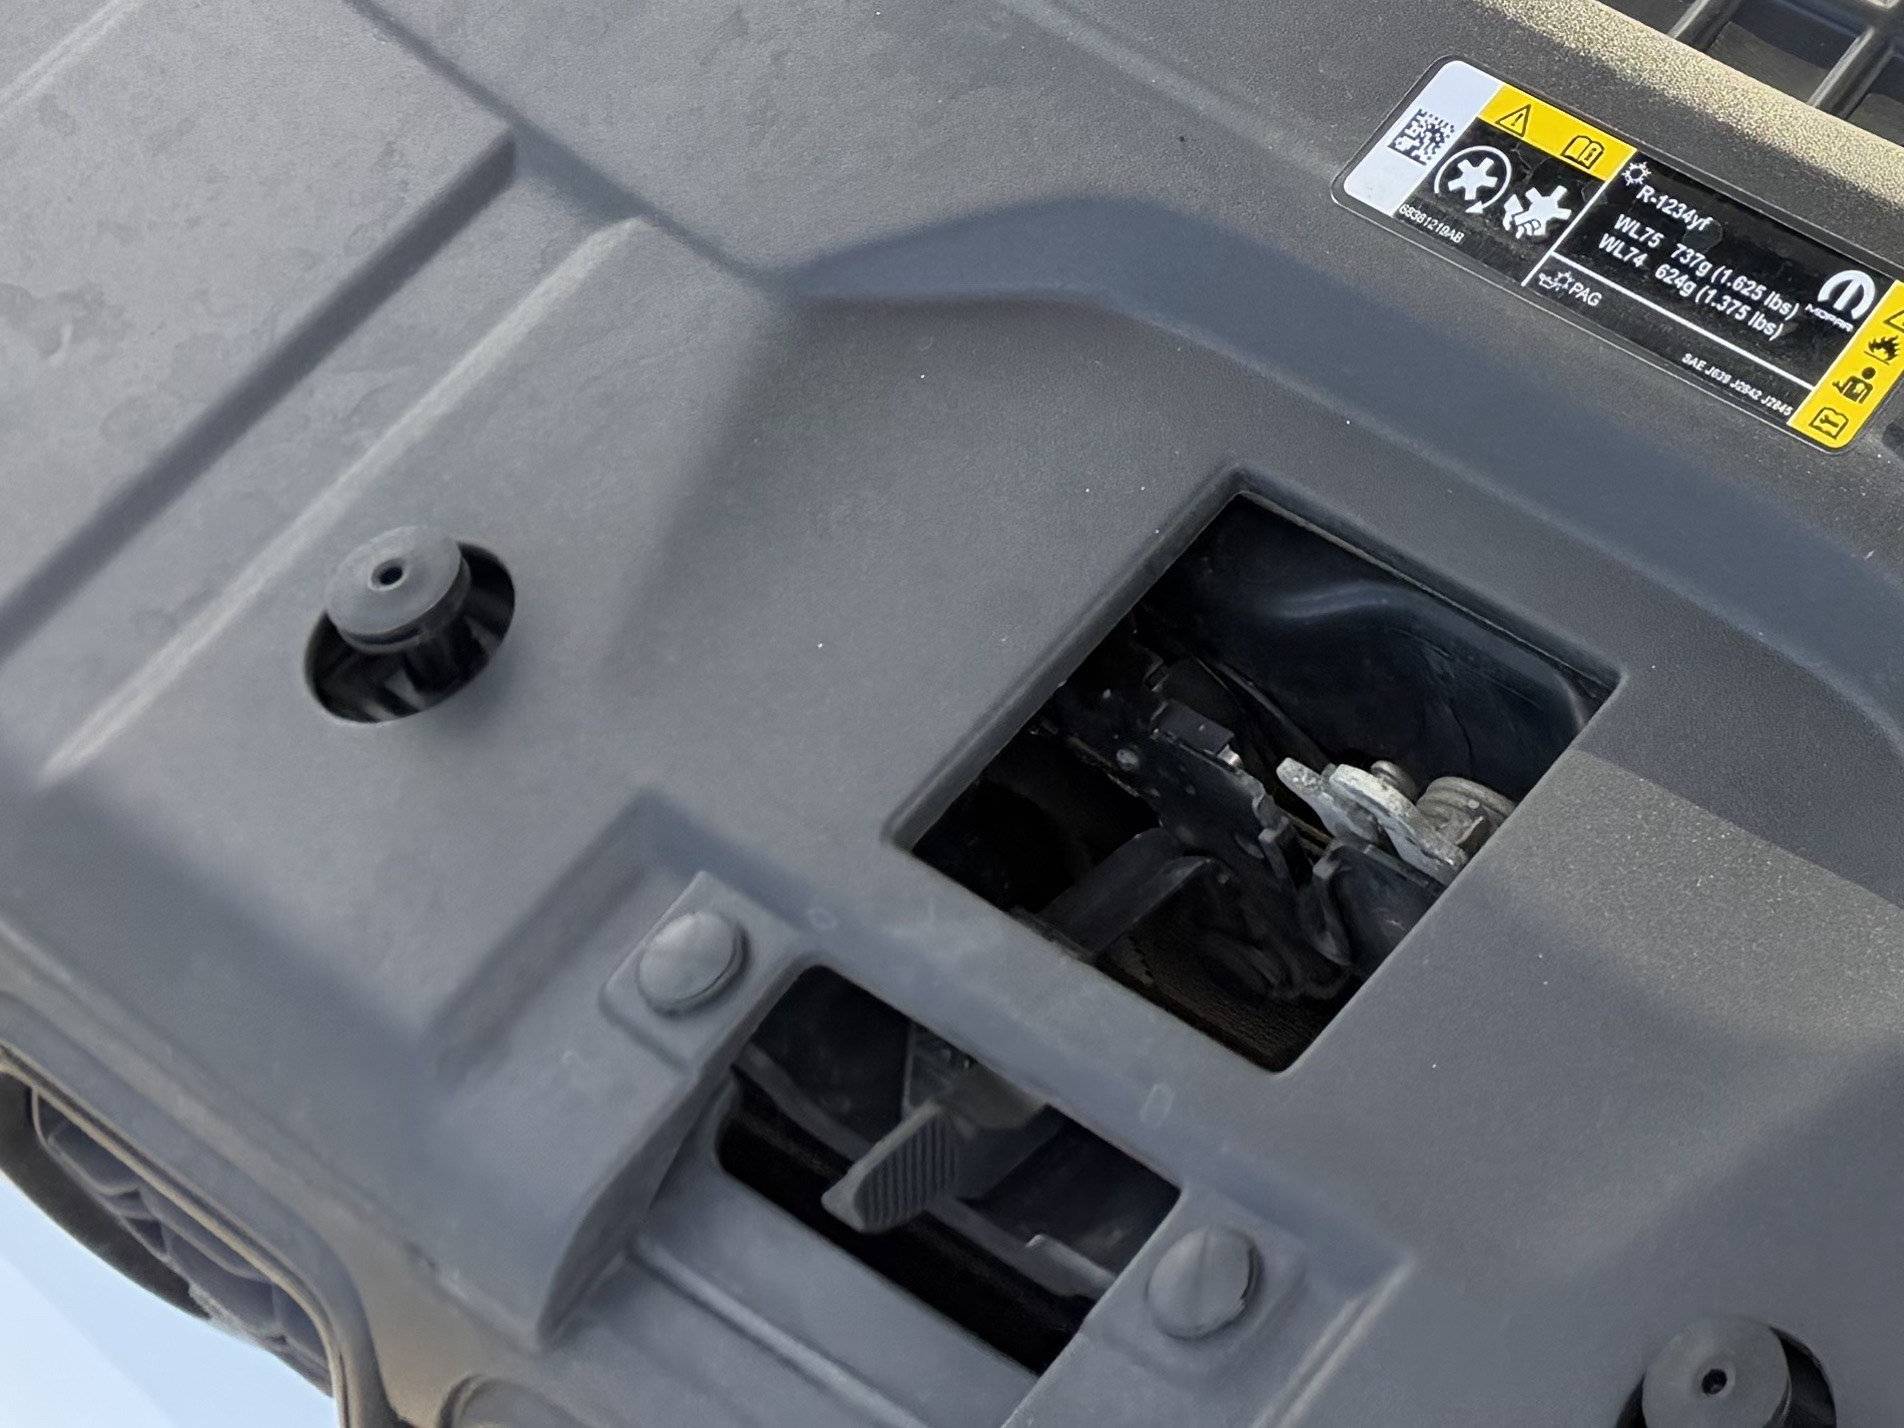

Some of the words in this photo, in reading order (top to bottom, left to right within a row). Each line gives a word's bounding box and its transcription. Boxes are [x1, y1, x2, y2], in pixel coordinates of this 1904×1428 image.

[1636, 185, 1713, 231] R-1234yf
[1613, 213, 1665, 248] WL75
[1670, 242, 1713, 278] 737g
[1711, 265, 1767, 301] (1.625
[1764, 293, 1800, 321] lbs)
[1568, 281, 1602, 307] PAG
[1598, 233, 1649, 268] WL74
[1655, 263, 1697, 299] 624g
[1695, 285, 1751, 321] (1.375
[1748, 312, 1784, 341] lbs)
[1804, 303, 1854, 332] MOPAR
[1681, 352, 1705, 372] SAE
